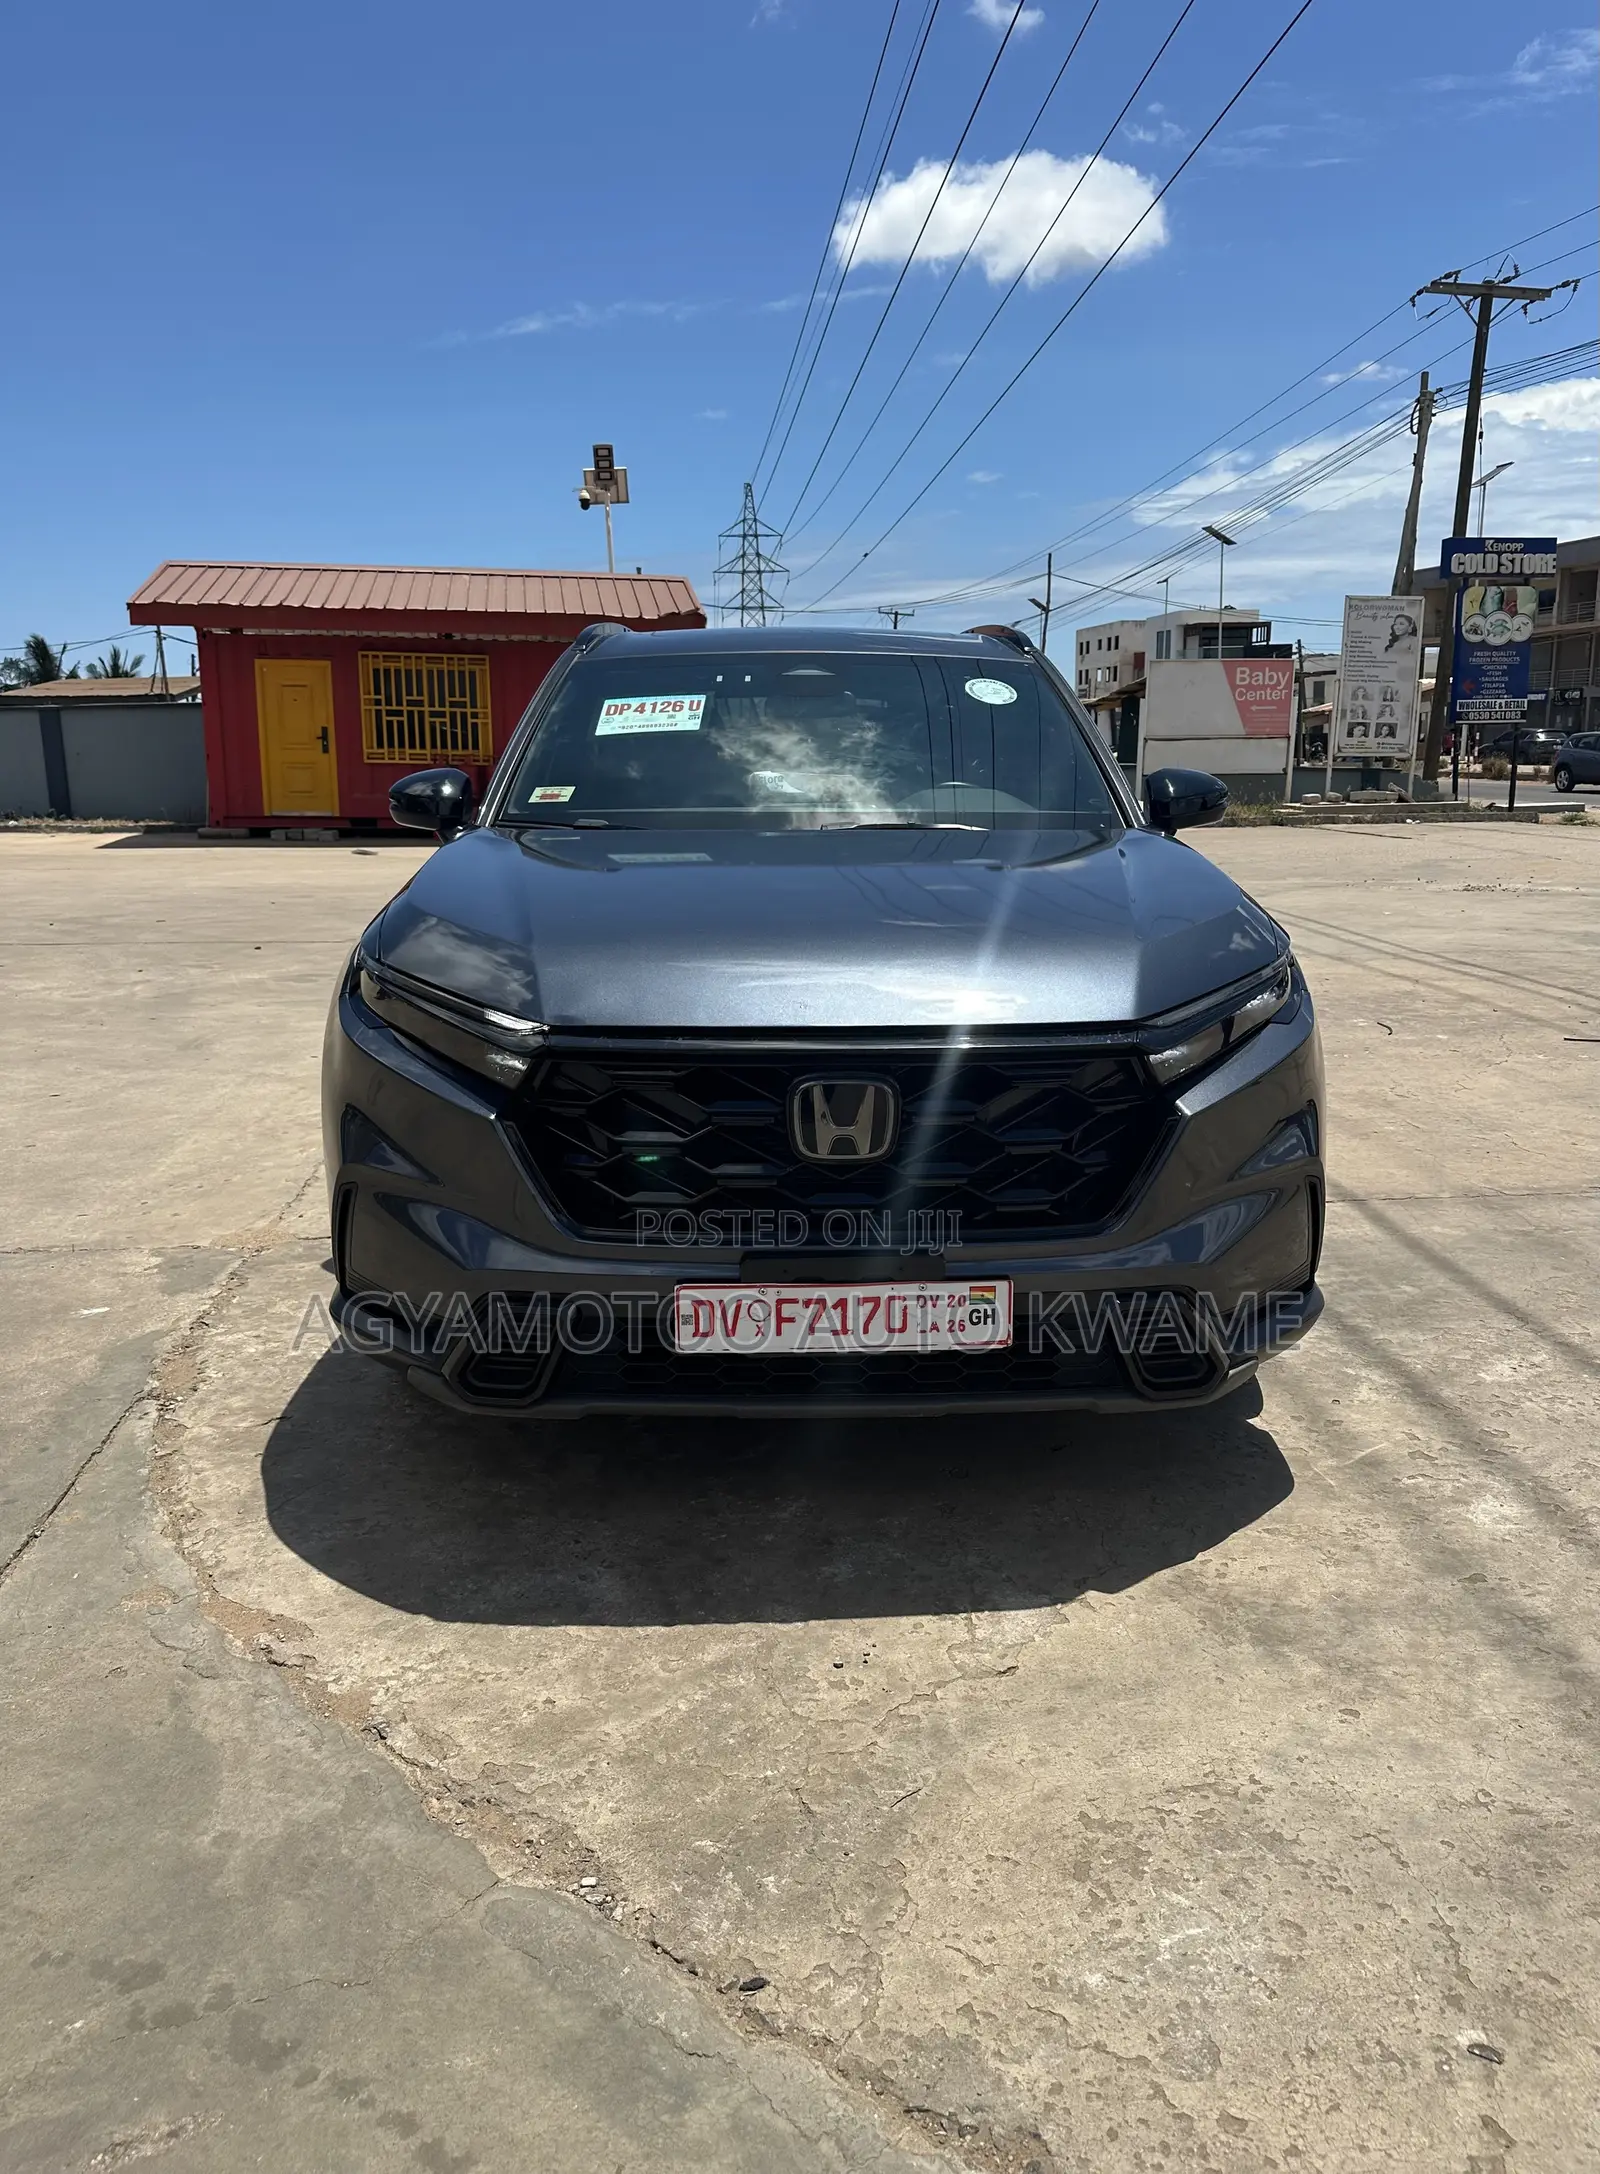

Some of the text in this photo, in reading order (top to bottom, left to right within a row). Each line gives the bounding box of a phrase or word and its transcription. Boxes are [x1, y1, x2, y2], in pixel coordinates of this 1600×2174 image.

[1485, 539, 1524, 552] KENOPP
[1451, 553, 1557, 574] COLD STORE
[1236, 667, 1290, 689] Baby
[1235, 688, 1288, 701] Center
[605, 704, 632, 716] DP
[688, 700, 702, 712] U
[1458, 700, 1526, 710] WHOLESALE & RETAIL
[1469, 711, 1521, 720] 0530 541083
[947, 1294, 966, 1308] 20
[691, 1298, 743, 1337] DV
[968, 1308, 996, 1326] GH
[947, 1320, 966, 1333] 26
